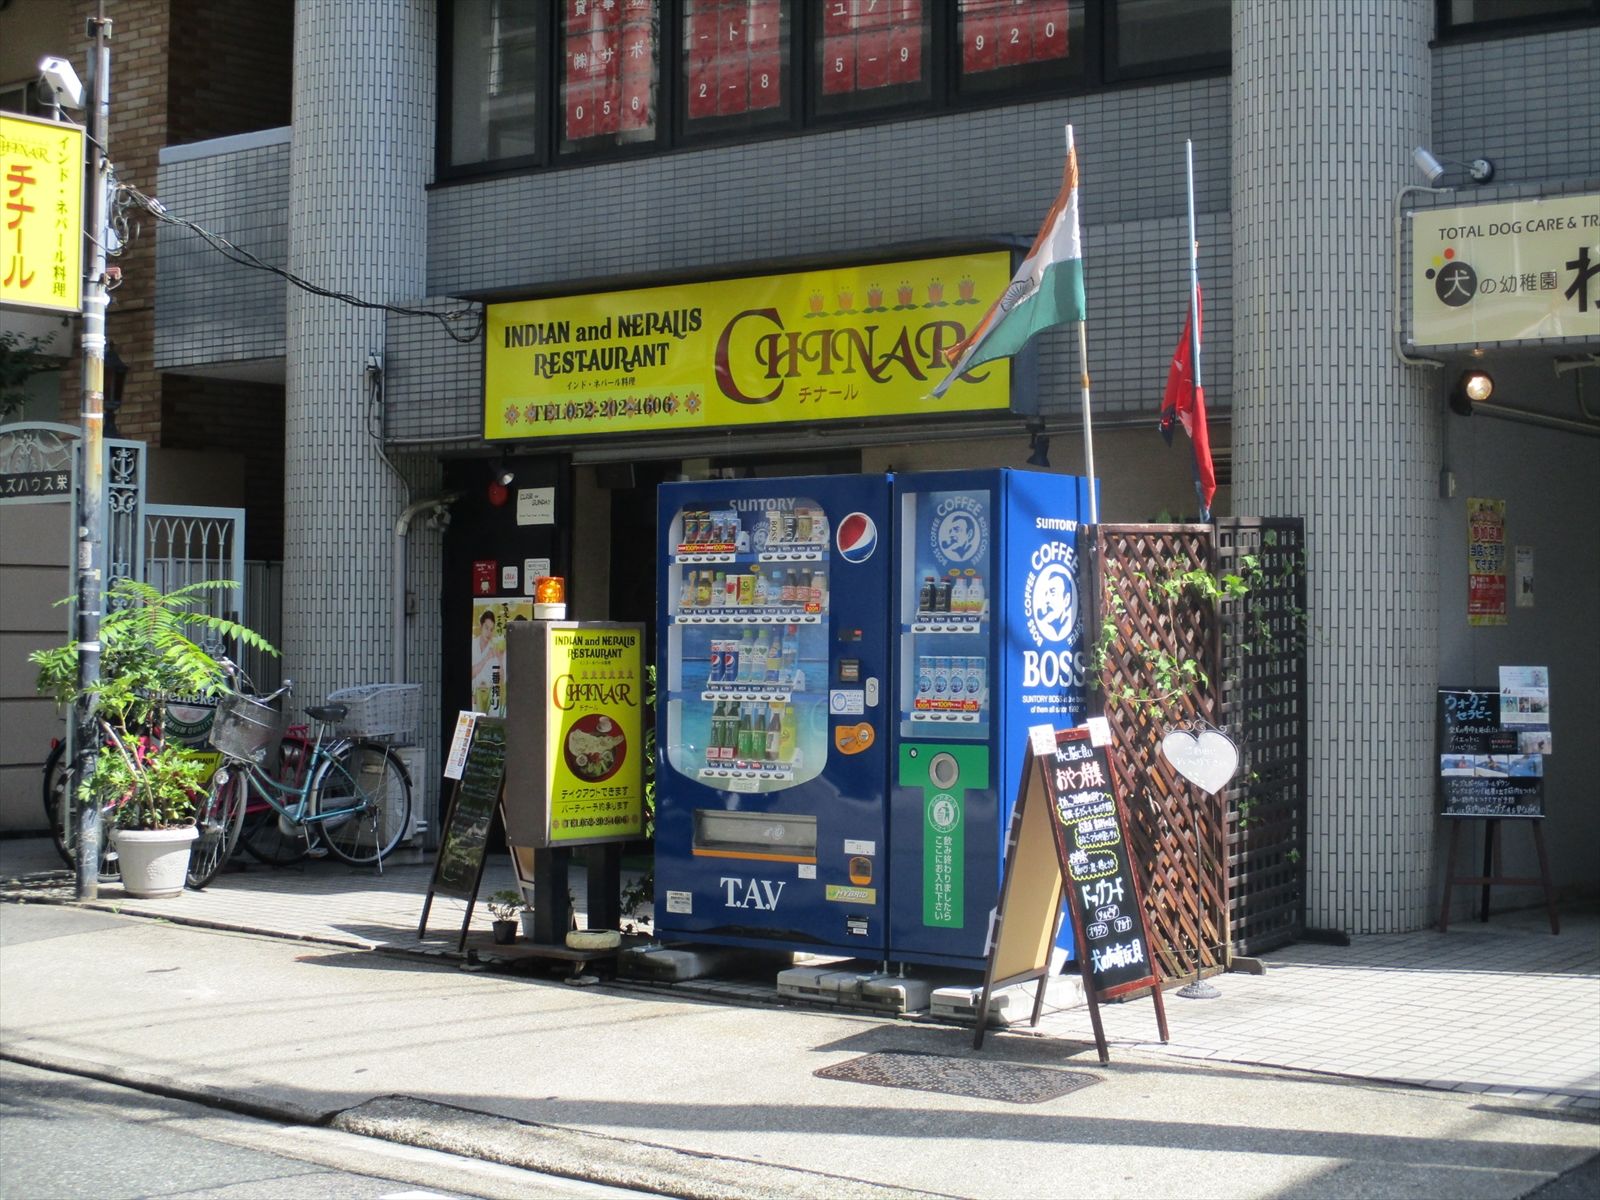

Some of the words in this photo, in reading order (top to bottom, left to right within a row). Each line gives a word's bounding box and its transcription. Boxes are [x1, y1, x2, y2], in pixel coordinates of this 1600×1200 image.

[576, 96, 640, 120] 056
[975, 22, 1055, 50] 920
[4, 164, 37, 289] チナール
[53, 136, 70, 298] インド・ネパール料理
[1439, 225, 1485, 241] TOTAL
[1489, 221, 1522, 236] DOG
[1526, 217, 1564, 233] CARE
[1567, 216, 1577, 229] &
[1581, 214, 1600, 228] TR
[1443, 269, 1558, 299] 犬の幼稚園
[504, 320, 570, 348] INDIAN
[575, 317, 612, 343] and
[617, 307, 702, 340] NEPALIS
[533, 342, 670, 379] RESTAURANT
[714, 307, 991, 405] CHINAR
[566, 376, 636, 391] インド・ネパール料理
[798, 383, 859, 404] チナール
[0, 474, 68, 493] ズハウス栄
[729, 498, 796, 512] SUNTORY
[936, 496, 983, 517] COFFEE
[1035, 516, 1078, 531] SUNTORY
[1031, 541, 1079, 574] COFFEE
[1024, 570, 1037, 617] COFFEE
[555, 636, 583, 646] INDIAN
[585, 636, 600, 646] and
[567, 648, 623, 660] RESTAURANT
[1022, 650, 1087, 688] BOSS
[553, 674, 637, 711] CHINAR
[1022, 695, 1048, 704] SUNTORY
[934, 836, 944, 921] ここにお入れ下さい
[943, 836, 952, 921] 飲み終わりましたら
[1081, 876, 1125, 911] ドッグフード
